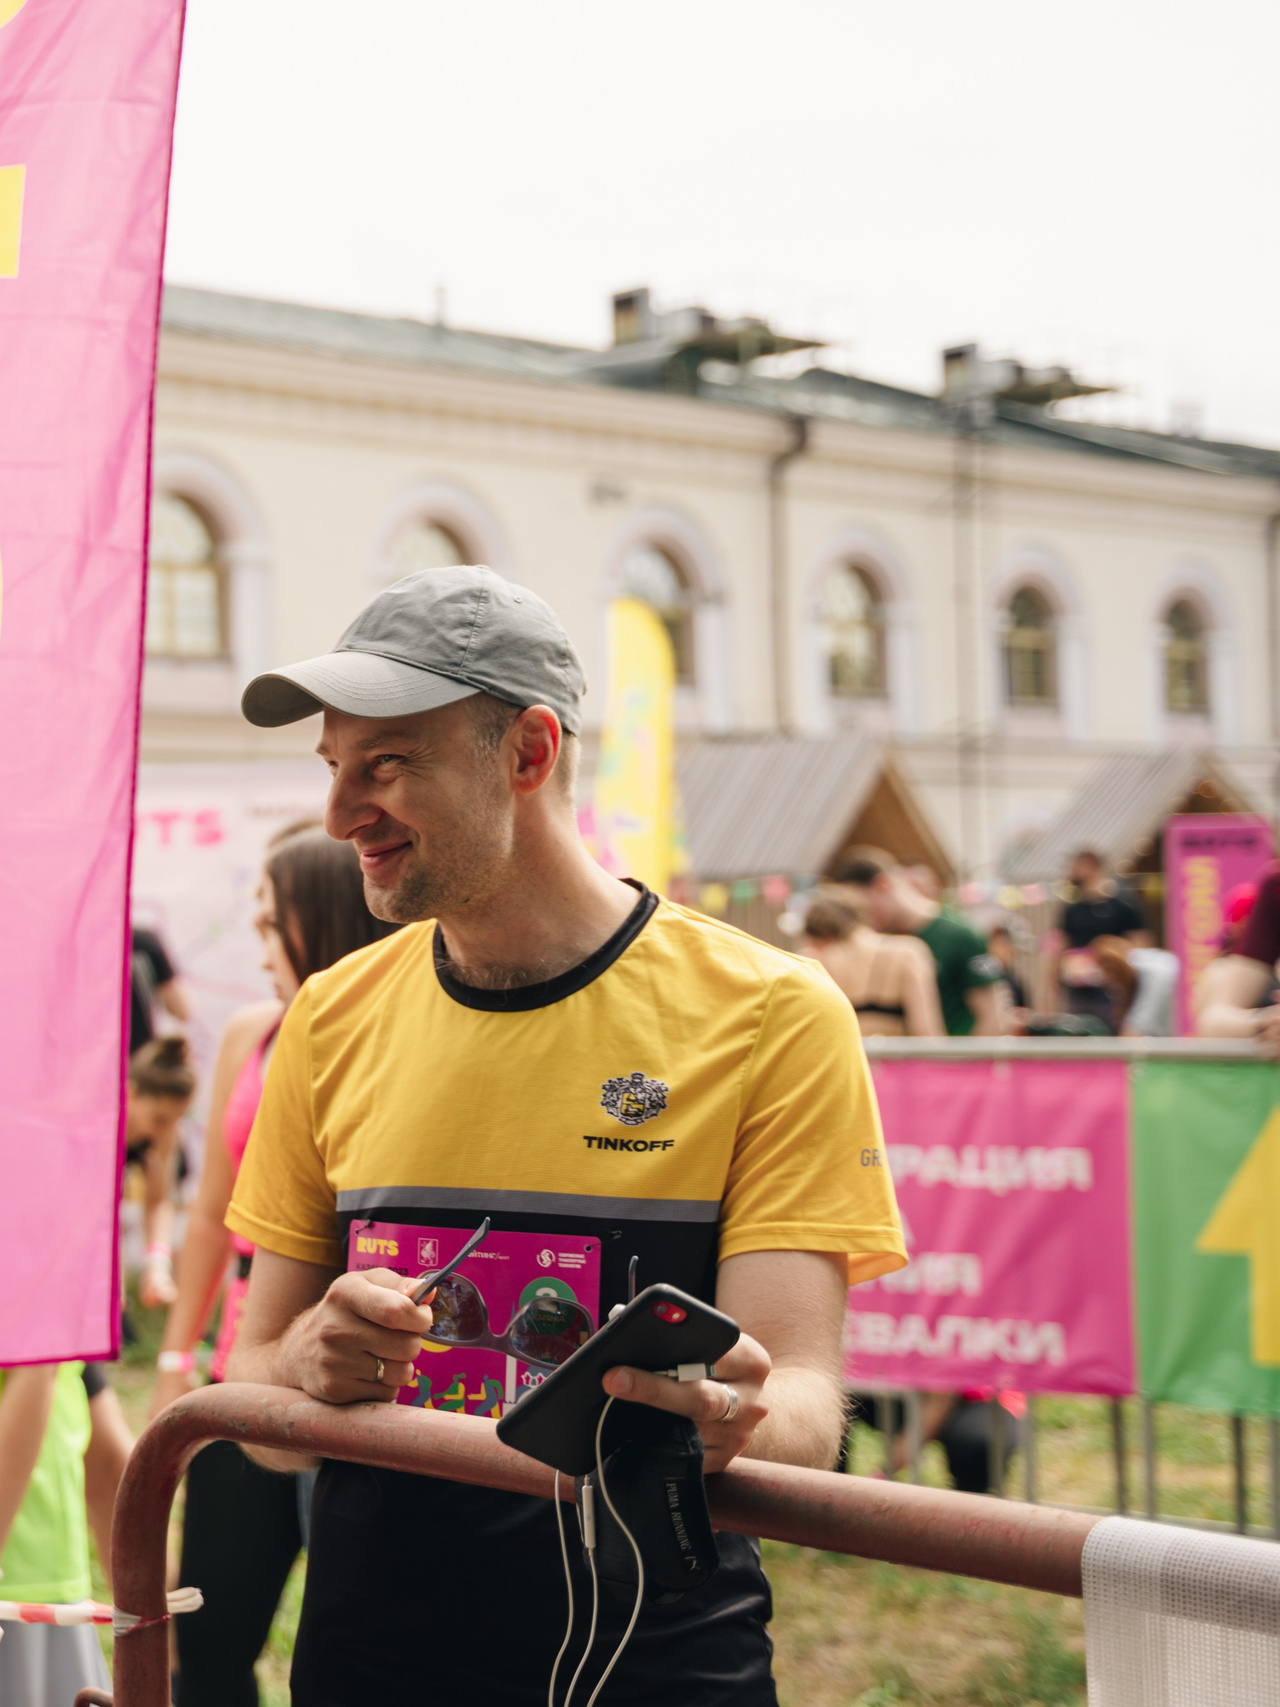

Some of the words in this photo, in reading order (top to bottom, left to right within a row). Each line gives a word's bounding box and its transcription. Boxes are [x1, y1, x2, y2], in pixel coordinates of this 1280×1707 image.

[583, 1135, 675, 1152] TINKOFF
[356, 1236, 399, 1257] RUTS
[666, 1483, 680, 1508] PUMA
[671, 1512, 692, 1550] RUNNING
